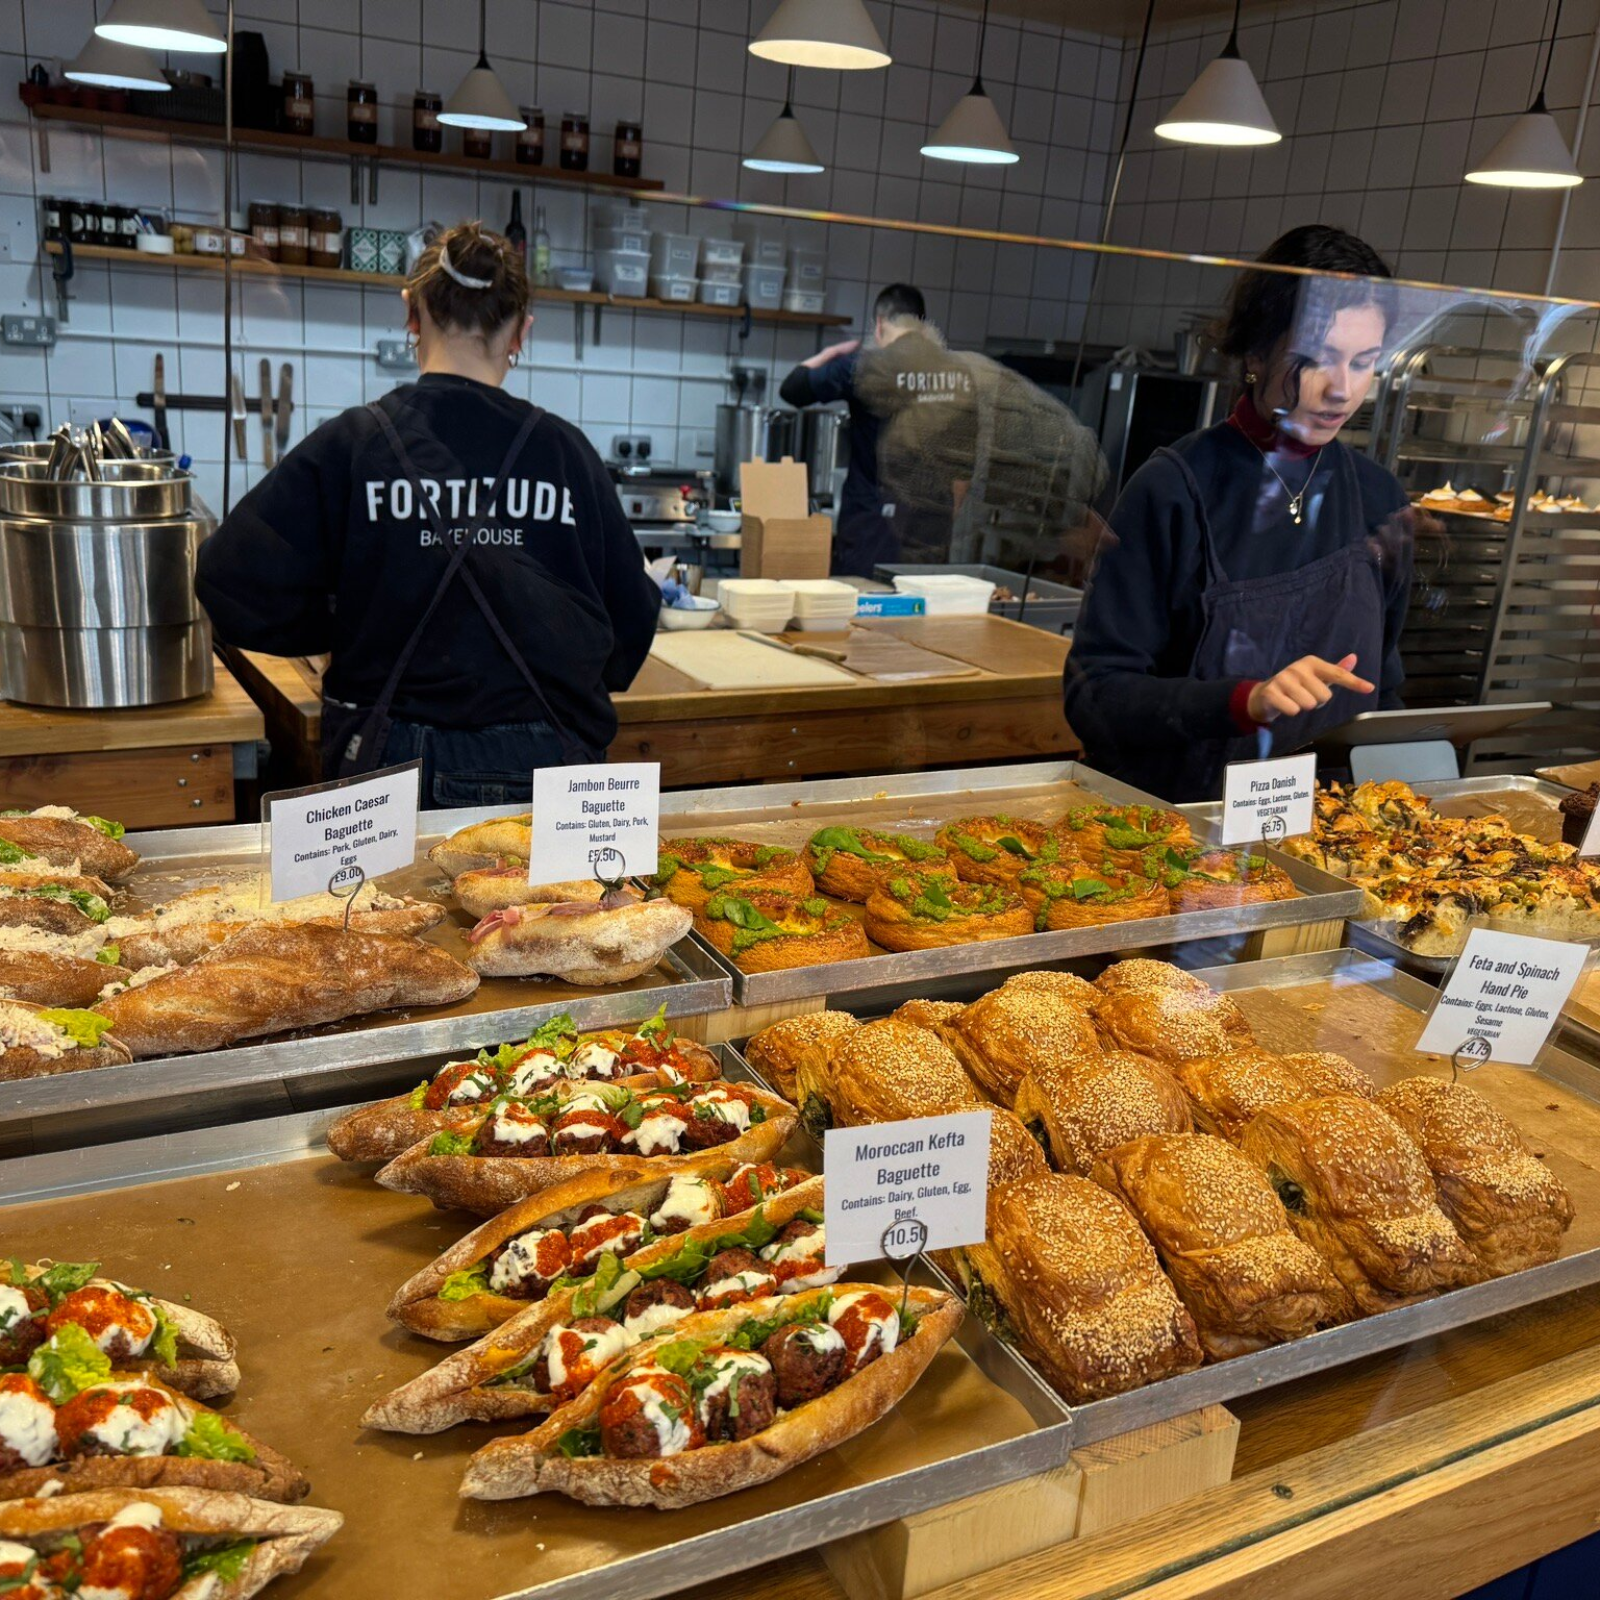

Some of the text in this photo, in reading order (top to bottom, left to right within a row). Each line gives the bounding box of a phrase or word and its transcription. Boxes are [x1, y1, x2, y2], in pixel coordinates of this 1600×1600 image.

[420, 528, 524, 546] BAEOUSE
[568, 778, 640, 793] Jambon Beurre
[1250, 775, 1296, 792] Pizza Danish
[306, 794, 390, 824] Chicken Caesar
[582, 800, 625, 815] Baguette
[1232, 799, 1257, 808] Contains:
[1256, 805, 1288, 817] VEGETARIAN
[325, 819, 373, 841] Baguette
[555, 820, 587, 831] Contains:
[588, 819, 611, 829] Gluten,
[632, 817, 649, 826] Pork,
[589, 832, 616, 843] Mustard
[294, 849, 331, 863] Contains:
[332, 843, 351, 855] Pork,
[353, 836, 378, 849] Gluten,
[340, 854, 357, 867] Eggs
[1469, 954, 1561, 981] Feta and Spinach
[1480, 980, 1529, 999] Hand Pie
[1440, 995, 1549, 1020] Contains: Eggs, Lactose, Gluten,
[1475, 1015, 1503, 1028] Sesame
[1466, 1027, 1501, 1039] VEGETARIAN
[855, 1132, 965, 1162] Moroccan Kefta
[877, 1162, 940, 1185] Baguette
[841, 1195, 886, 1210] Contains:
[917, 1186, 950, 1199] Gluten,
[894, 1207, 918, 1219] Beef.
